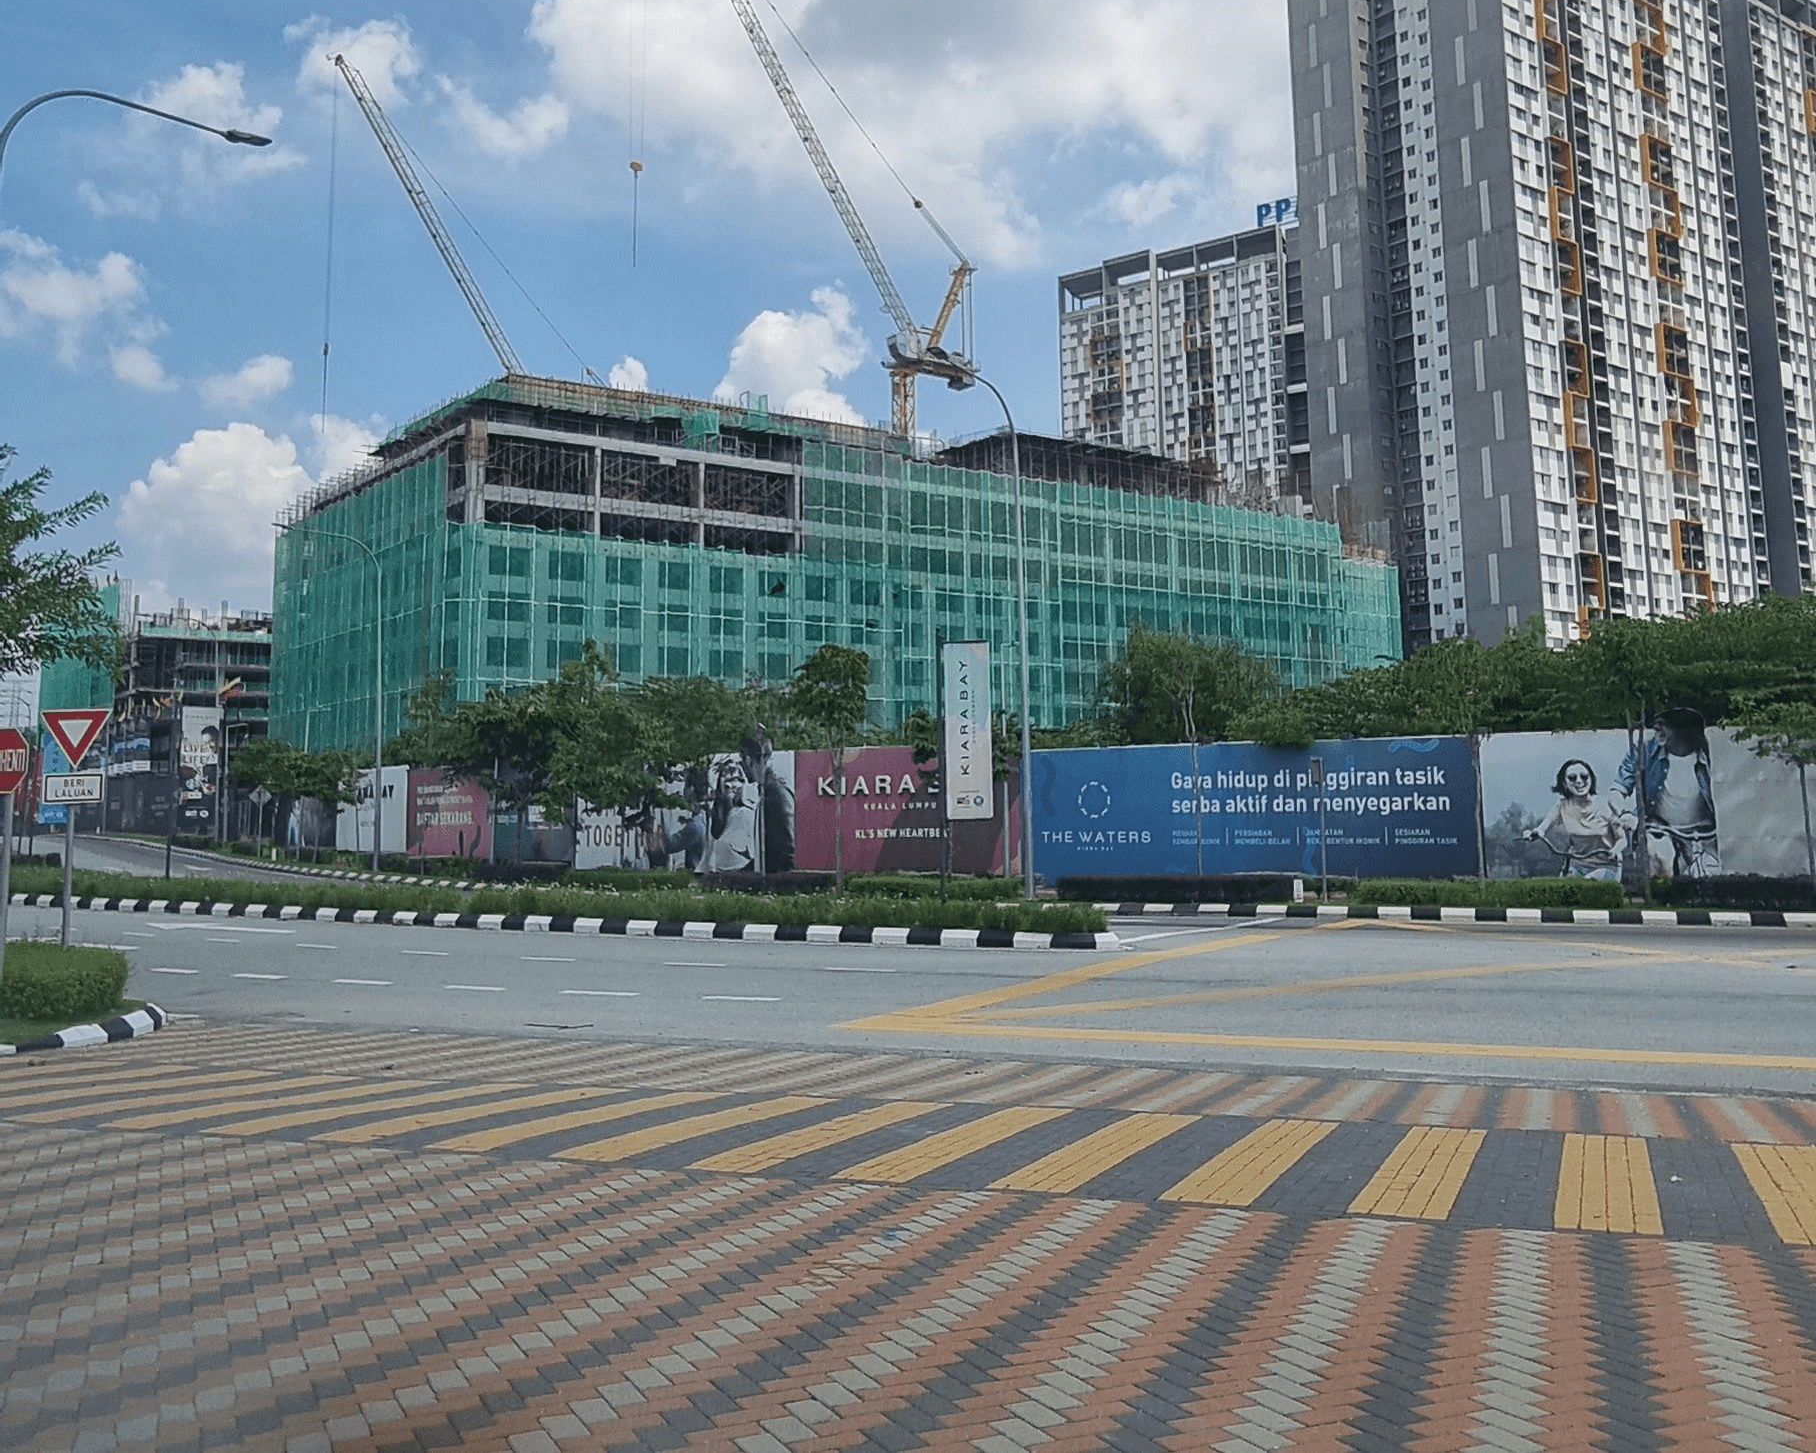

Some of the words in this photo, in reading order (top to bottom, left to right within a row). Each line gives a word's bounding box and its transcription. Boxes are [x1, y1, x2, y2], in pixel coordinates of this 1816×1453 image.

[1257, 198, 1297, 228] PP
[958, 660, 969, 701] BAY
[959, 708, 970, 776] KIARA
[63, 779, 85, 787] BERI
[817, 774, 916, 796] KIARA
[1171, 771, 1212, 794] Gaya
[1217, 770, 1268, 792] hidup
[1273, 769, 1291, 788] di
[1296, 766, 1390, 792] piggiran
[1395, 766, 1446, 786] tasik
[55, 789, 93, 798] LALUAN
[1171, 794, 1220, 814] serba
[1225, 794, 1268, 813] aktif
[1272, 794, 1307, 813] dan
[1313, 792, 1451, 816] menyegarkan
[863, 802, 897, 810] KUALA
[902, 801, 937, 809] LUMPU
[855, 829, 875, 839] KL'S
[877, 828, 897, 838] NEW
[899, 827, 950, 838] HEARTBE
[1042, 831, 1073, 844] THE
[1078, 830, 1152, 844] WATERS
